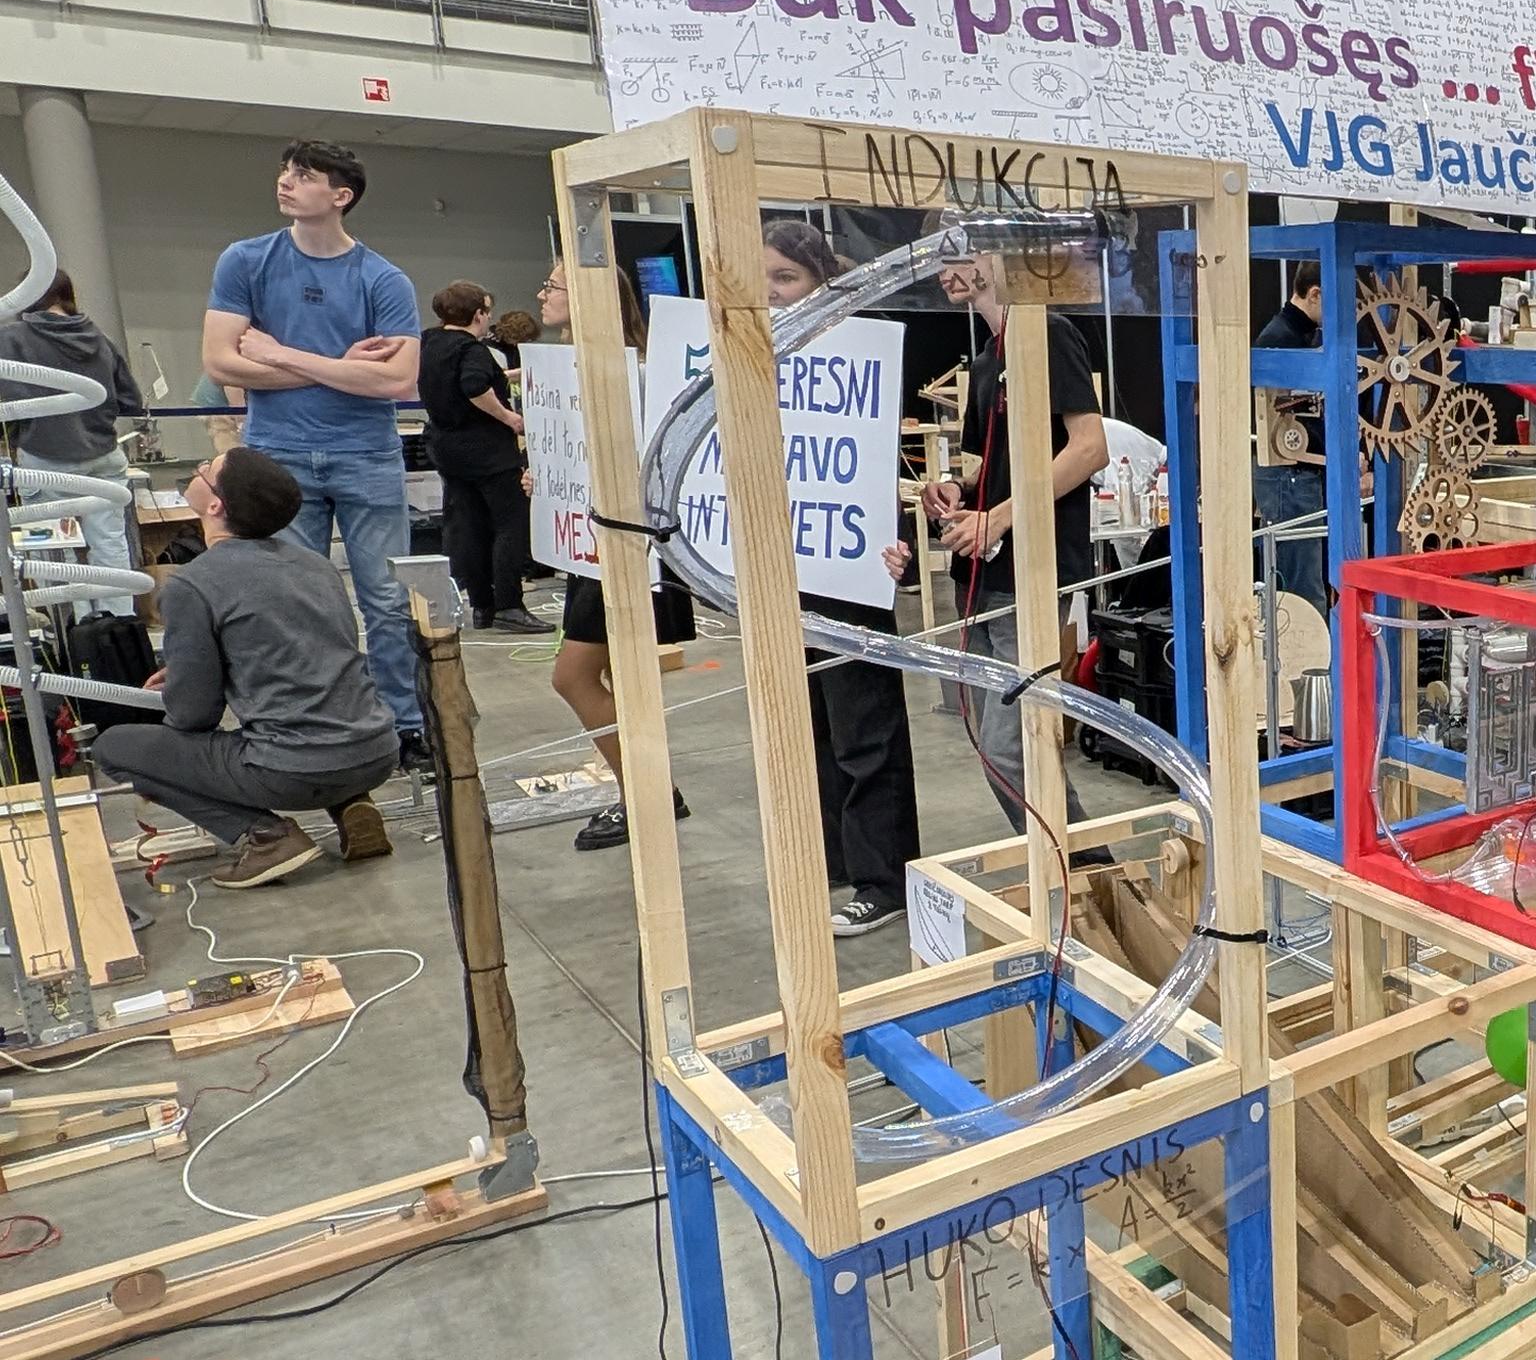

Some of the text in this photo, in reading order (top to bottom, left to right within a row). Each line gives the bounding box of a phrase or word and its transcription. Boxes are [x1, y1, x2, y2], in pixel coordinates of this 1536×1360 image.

[803, 123, 1127, 213] INDUKCIJA
[1266, 103, 1394, 177] VJG
[784, 435, 859, 484] AVO
[876, 1127, 1187, 1309] HUKO DĖSNIS
